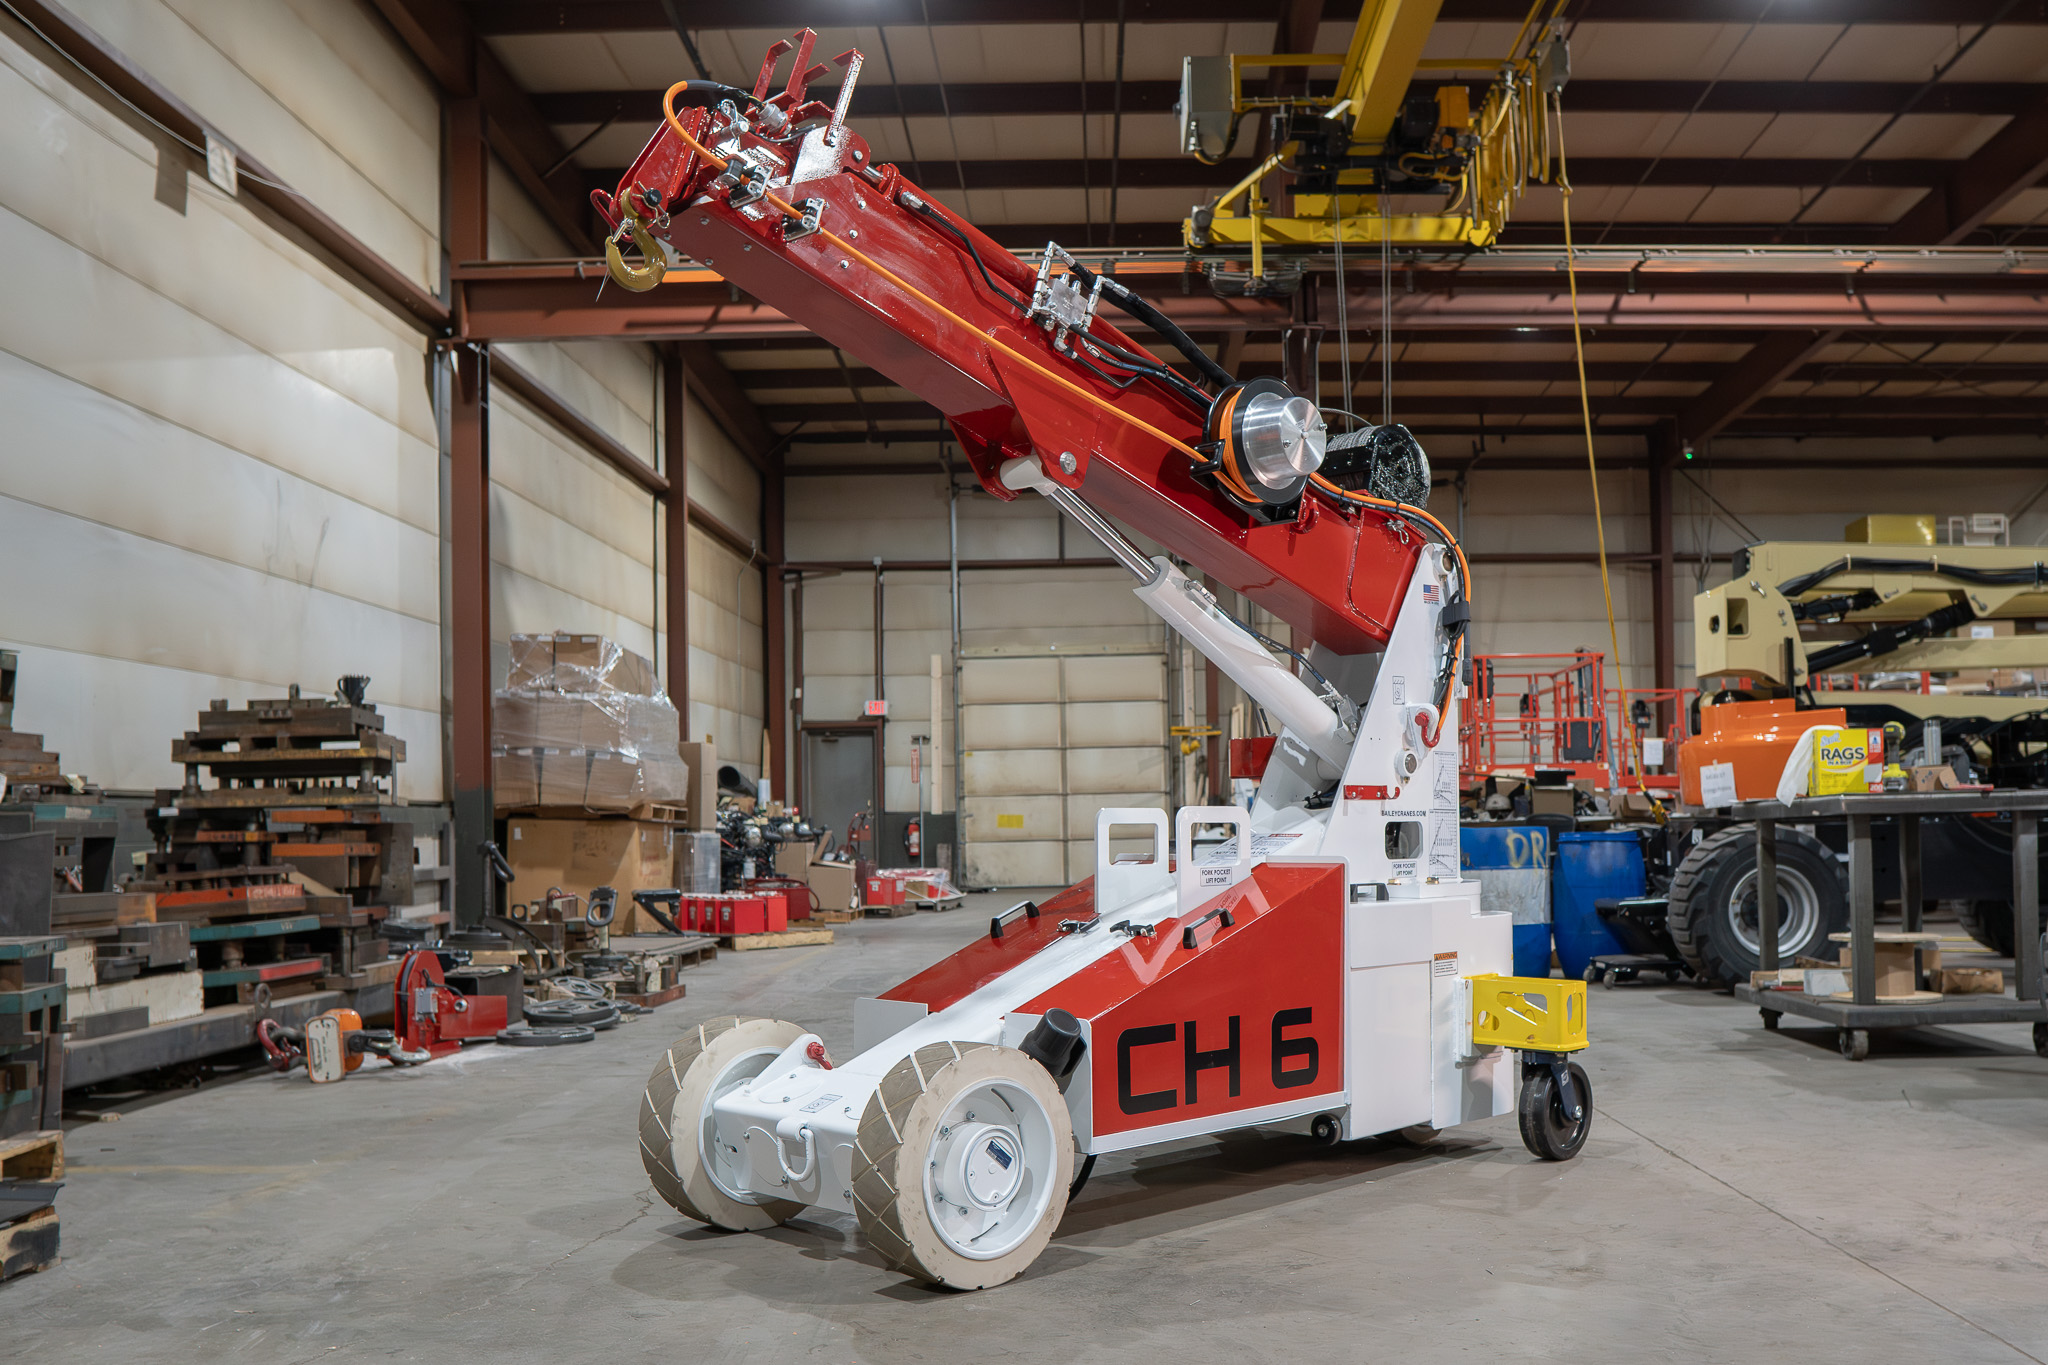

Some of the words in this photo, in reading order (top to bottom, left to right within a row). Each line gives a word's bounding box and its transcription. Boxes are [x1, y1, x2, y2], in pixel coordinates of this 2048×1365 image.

[869, 701, 885, 715] EXIT
[1821, 747, 1865, 761] RAGS
[1870, 784, 1883, 792] 200
[1213, 868, 1231, 876] POCKET
[1117, 1015, 1241, 1116] CH
[1271, 1007, 1319, 1089] 6
